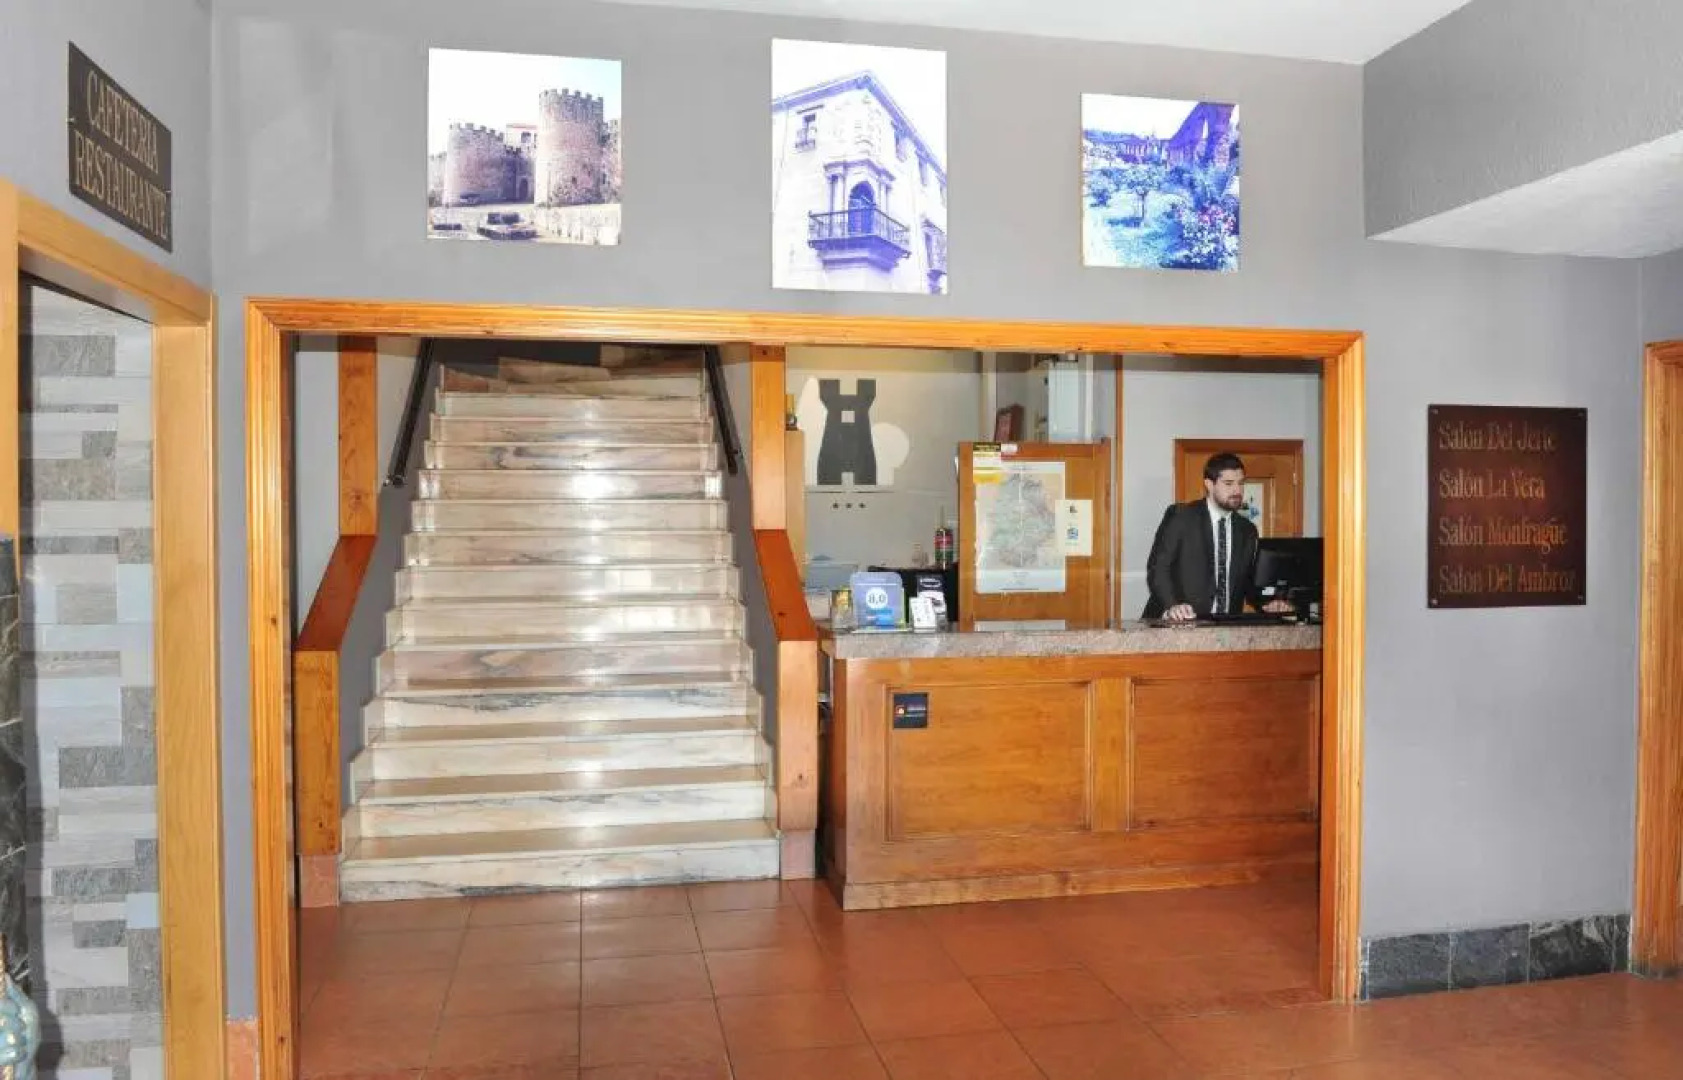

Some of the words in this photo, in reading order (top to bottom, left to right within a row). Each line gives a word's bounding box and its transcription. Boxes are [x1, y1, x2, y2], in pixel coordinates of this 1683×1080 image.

[86, 70, 158, 175] CAFETERIA
[74, 129, 168, 240] RESTAURANTE
[1487, 421, 1512, 451] Del
[1487, 469, 1507, 497] La
[1512, 469, 1546, 499] Vera
[1488, 564, 1513, 593] Del
